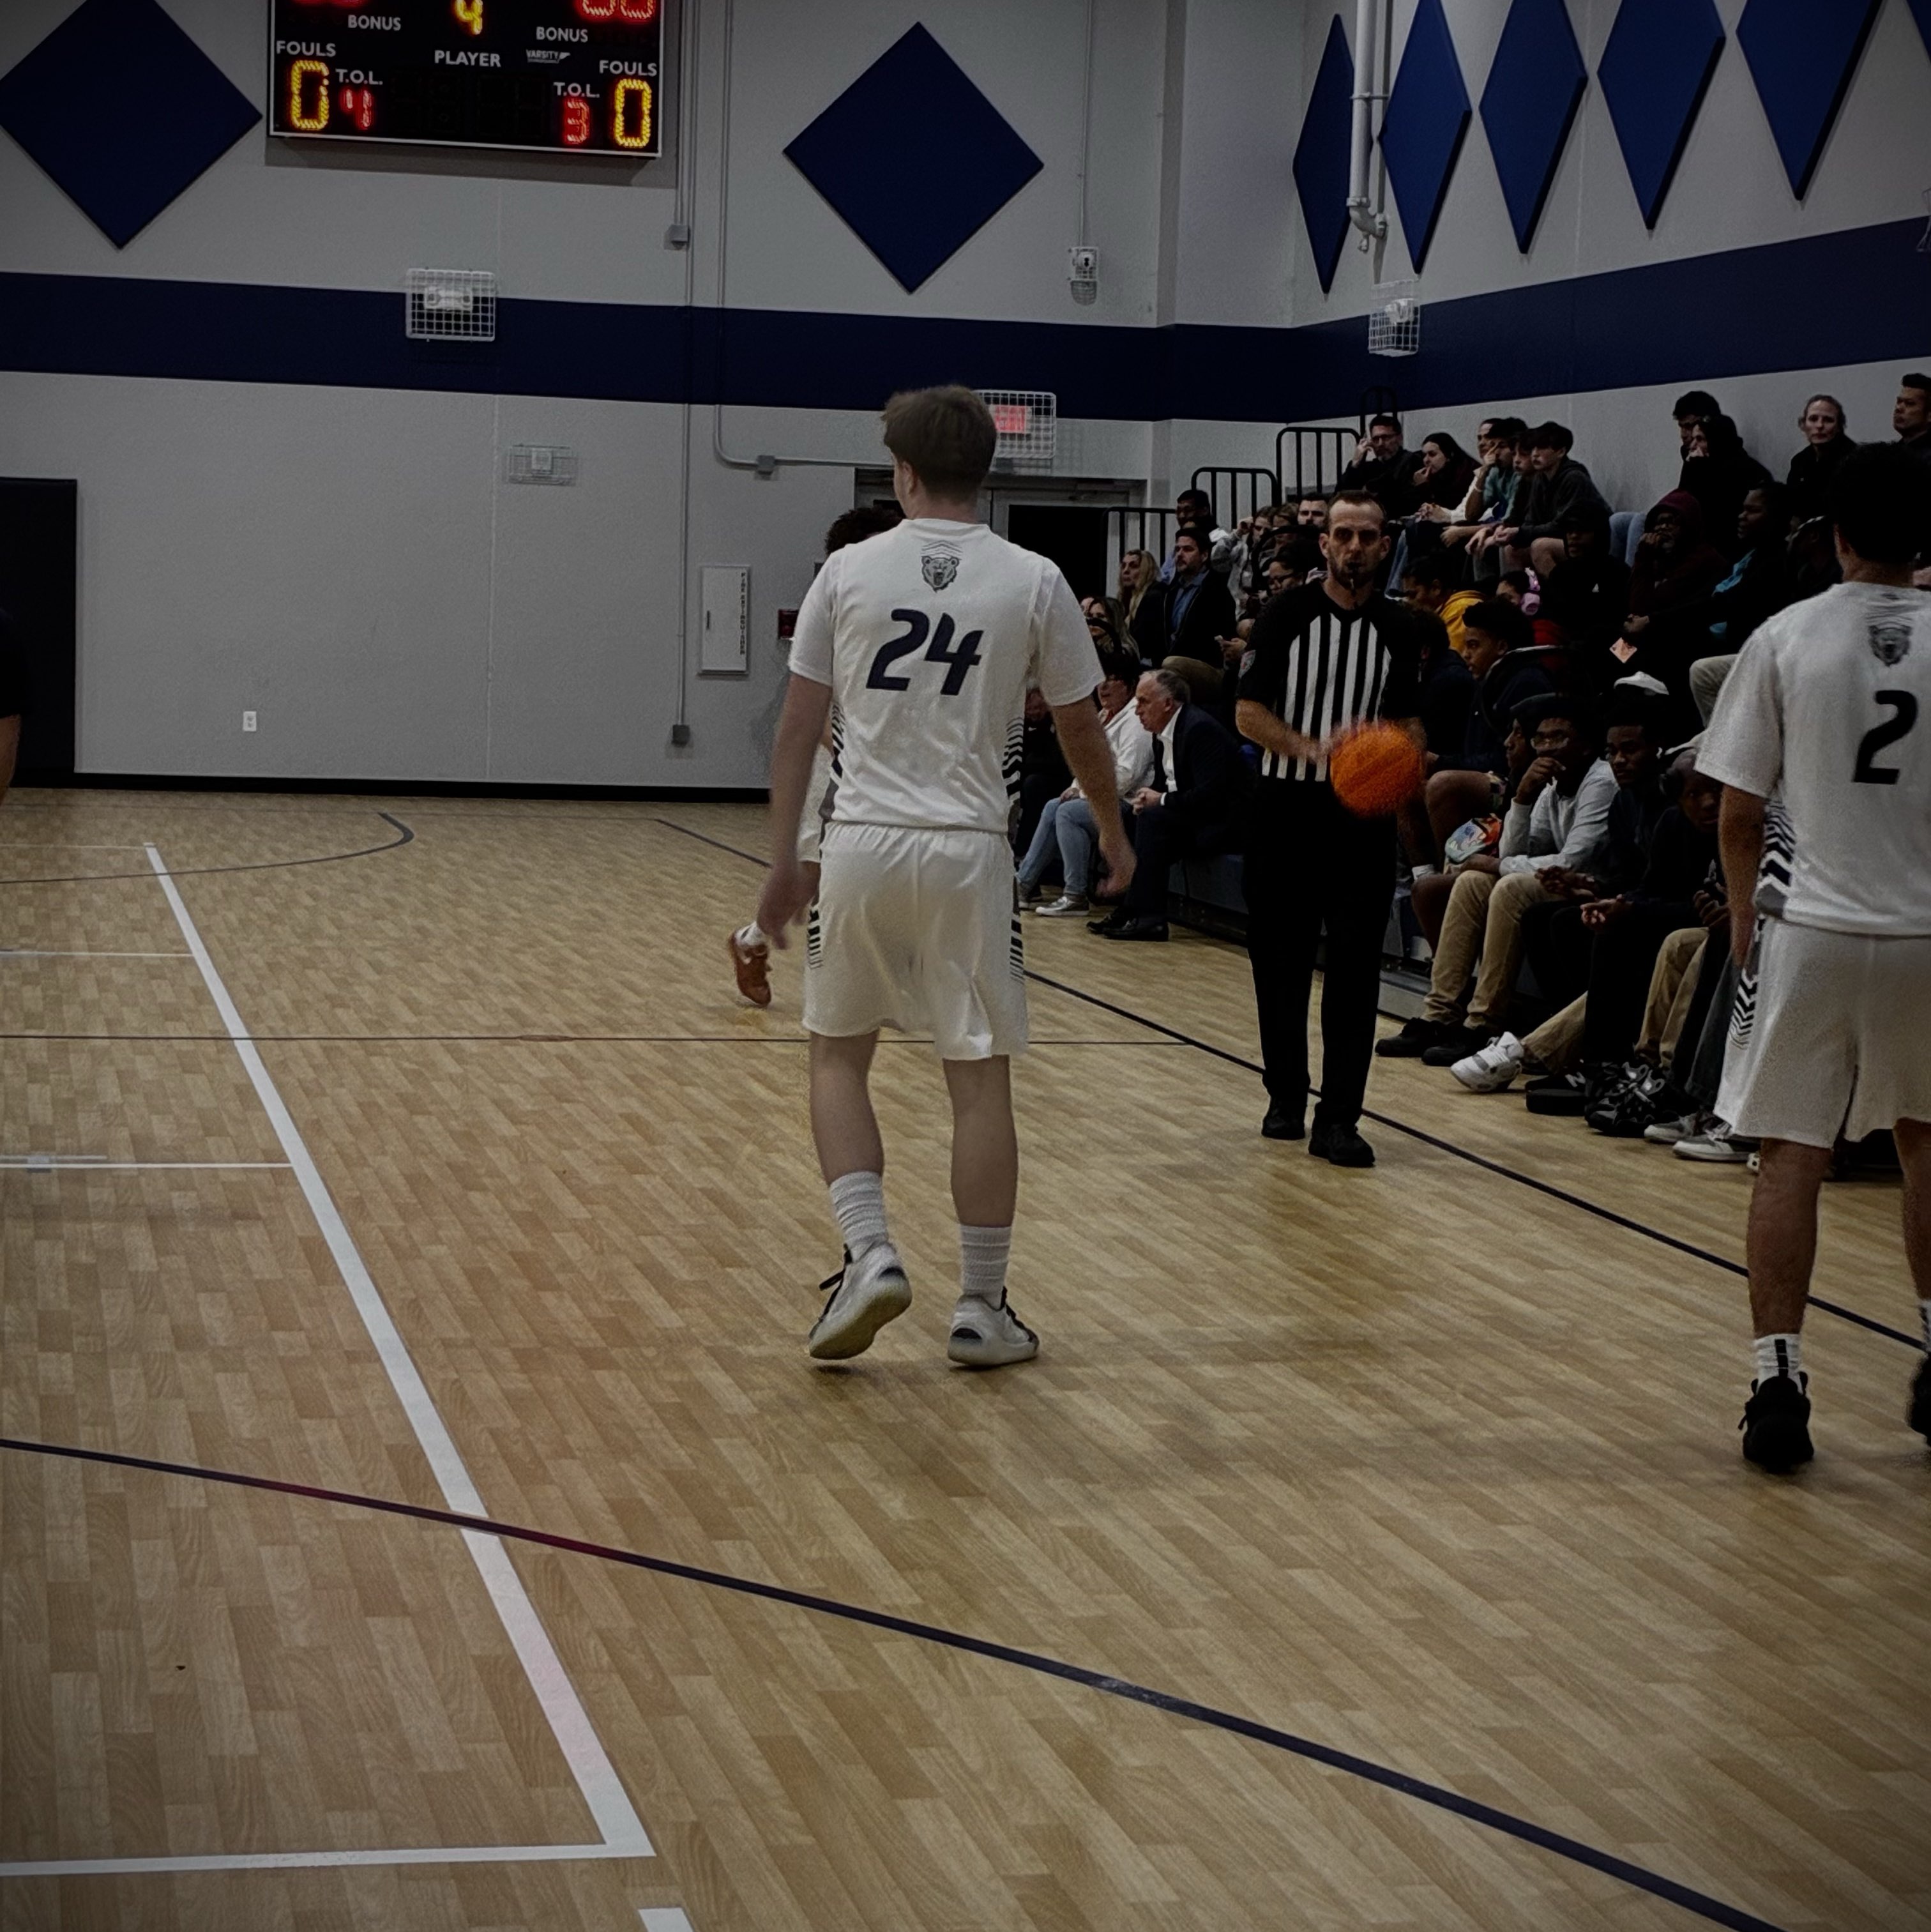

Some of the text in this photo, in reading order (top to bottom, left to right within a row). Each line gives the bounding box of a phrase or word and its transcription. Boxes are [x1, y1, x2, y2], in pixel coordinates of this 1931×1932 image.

[347, 14, 402, 31] BONUS
[453, 0, 483, 35] 4
[536, 26, 588, 43] BONUS
[276, 40, 337, 57] FOULS
[526, 49, 559, 59] VARSITY
[434, 49, 501, 68] PLAYER
[599, 59, 657, 77] FOULS
[335, 68, 383, 86] T.O.L.
[291, 59, 329, 132] 0
[553, 81, 600, 98] T.O.L.
[345, 87, 372, 128] 4
[614, 78, 652, 149] 0
[566, 98, 590, 144] 3
[866, 609, 984, 696] 24
[1853, 690, 1917, 784] 2
